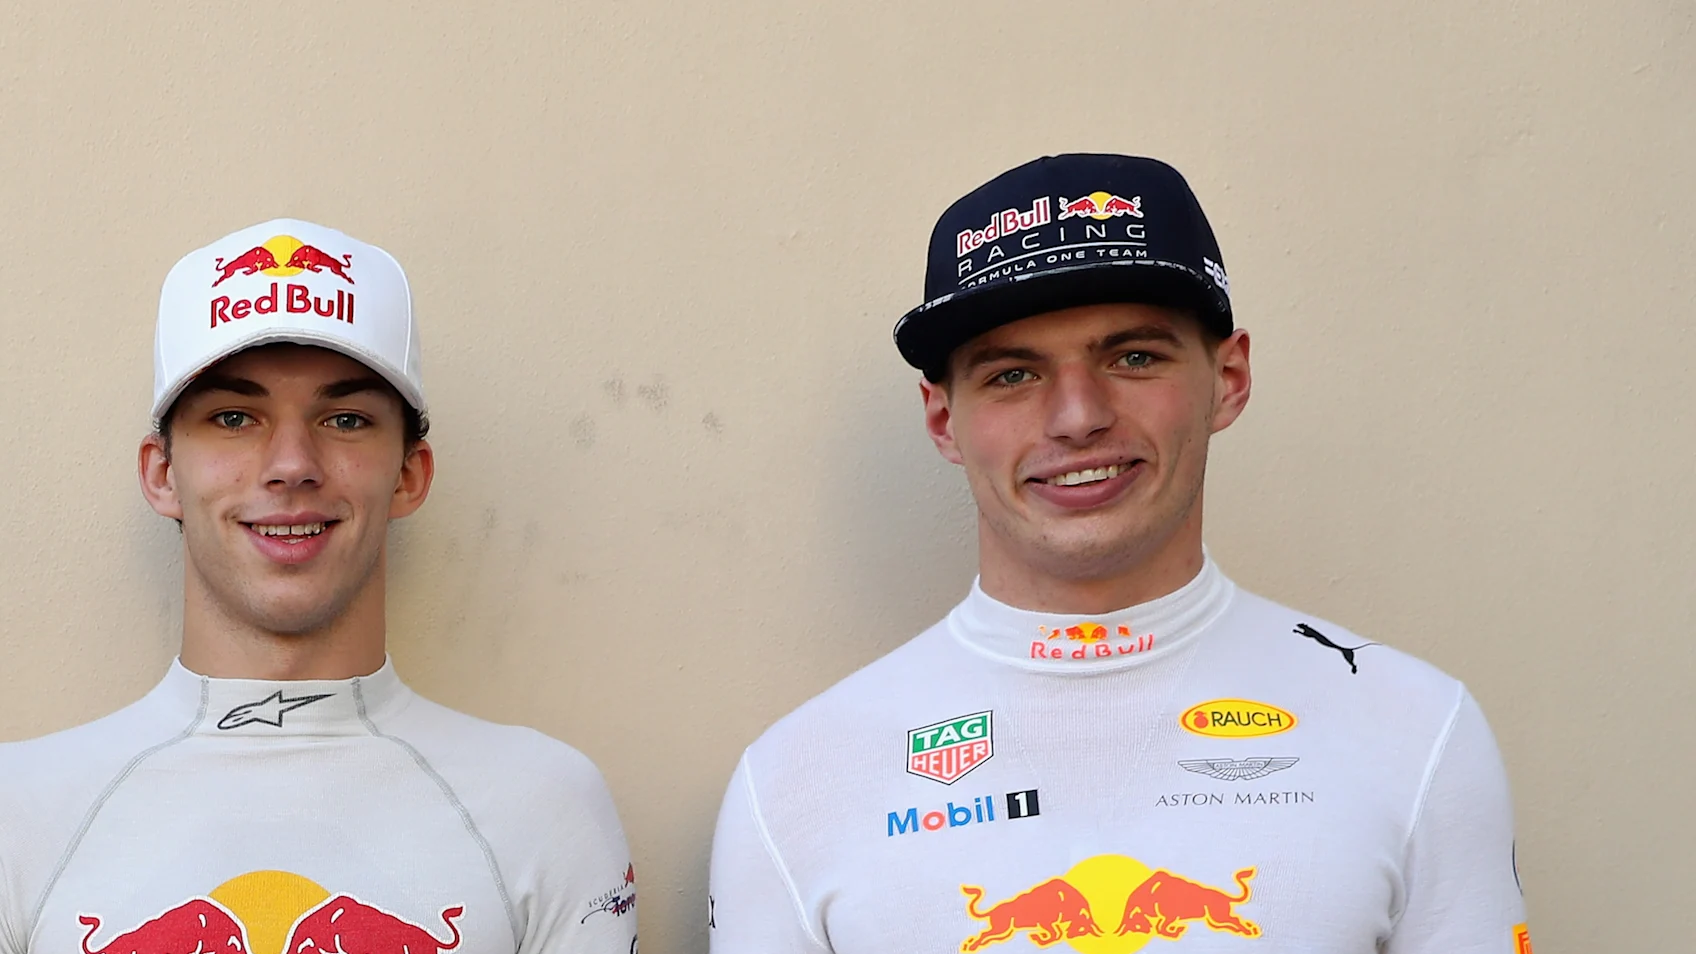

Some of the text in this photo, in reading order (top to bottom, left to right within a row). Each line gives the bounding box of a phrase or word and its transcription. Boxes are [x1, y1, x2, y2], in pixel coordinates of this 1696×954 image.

[957, 197, 1051, 258] Red Bull
[958, 223, 1146, 278] RACING
[962, 248, 1148, 290] ORMULA ONE TEAM
[211, 283, 354, 328] Red Bull
[1031, 634, 1153, 659] Red Bull
[916, 718, 983, 750] TAG
[1211, 711, 1282, 727] RAUCH
[914, 742, 986, 778] HEUER
[887, 796, 994, 837] Mobil
[1155, 791, 1314, 807] ASTON MARTIN
